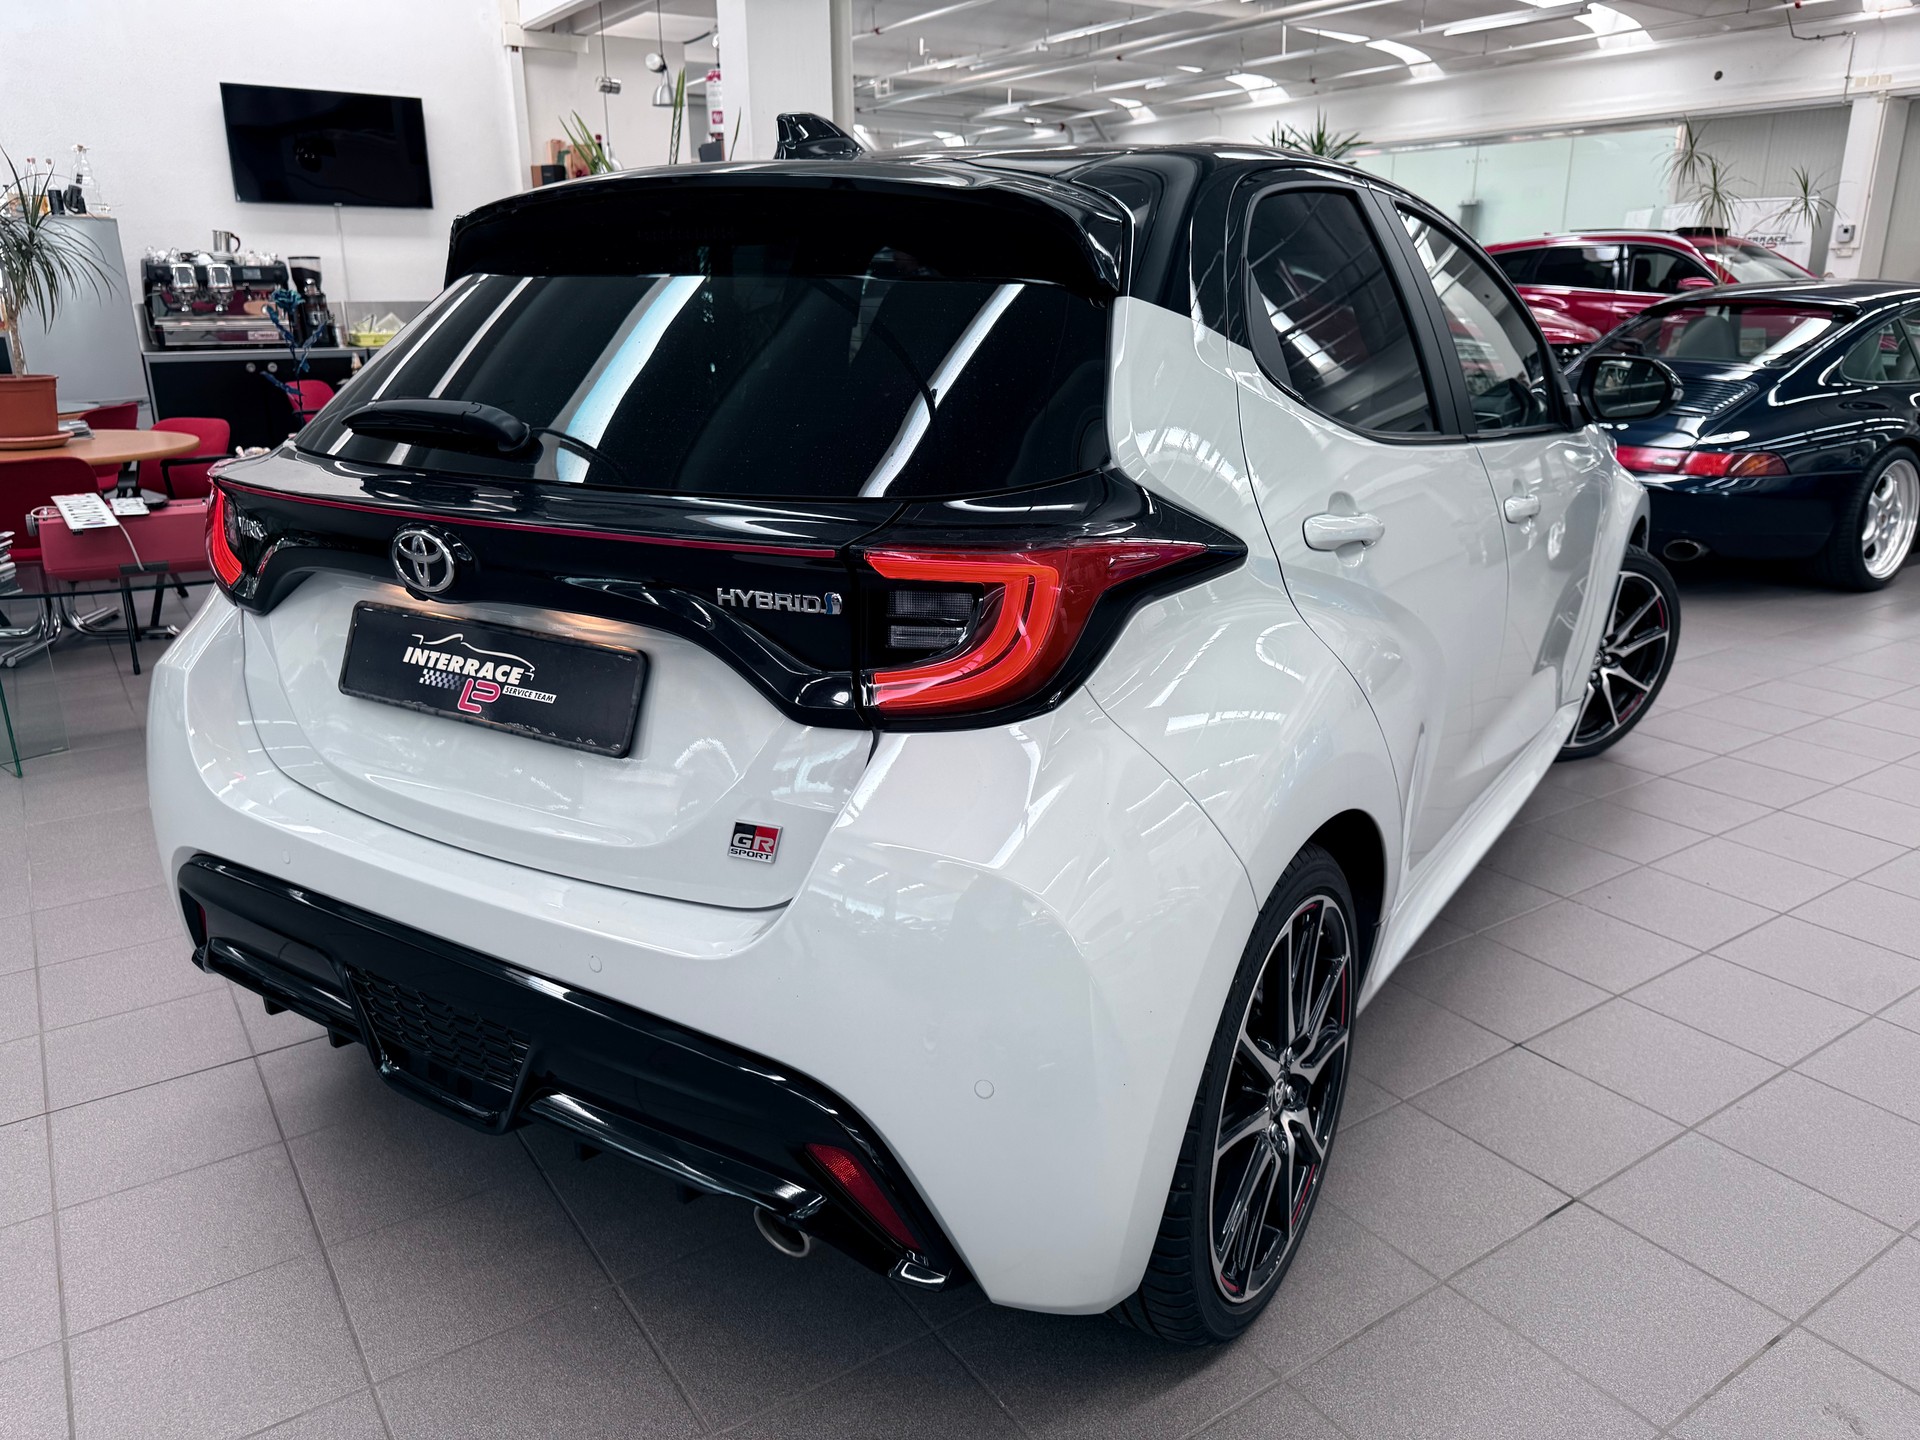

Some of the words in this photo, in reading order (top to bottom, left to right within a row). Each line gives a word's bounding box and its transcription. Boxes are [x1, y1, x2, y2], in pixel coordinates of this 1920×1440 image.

[716, 587, 821, 614] HYBRID
[402, 646, 525, 685] INTERRACE
[504, 686, 534, 699] SERVICE
[533, 693, 555, 703] TEAM
[732, 832, 775, 852] GR
[730, 847, 772, 860] SPORT
